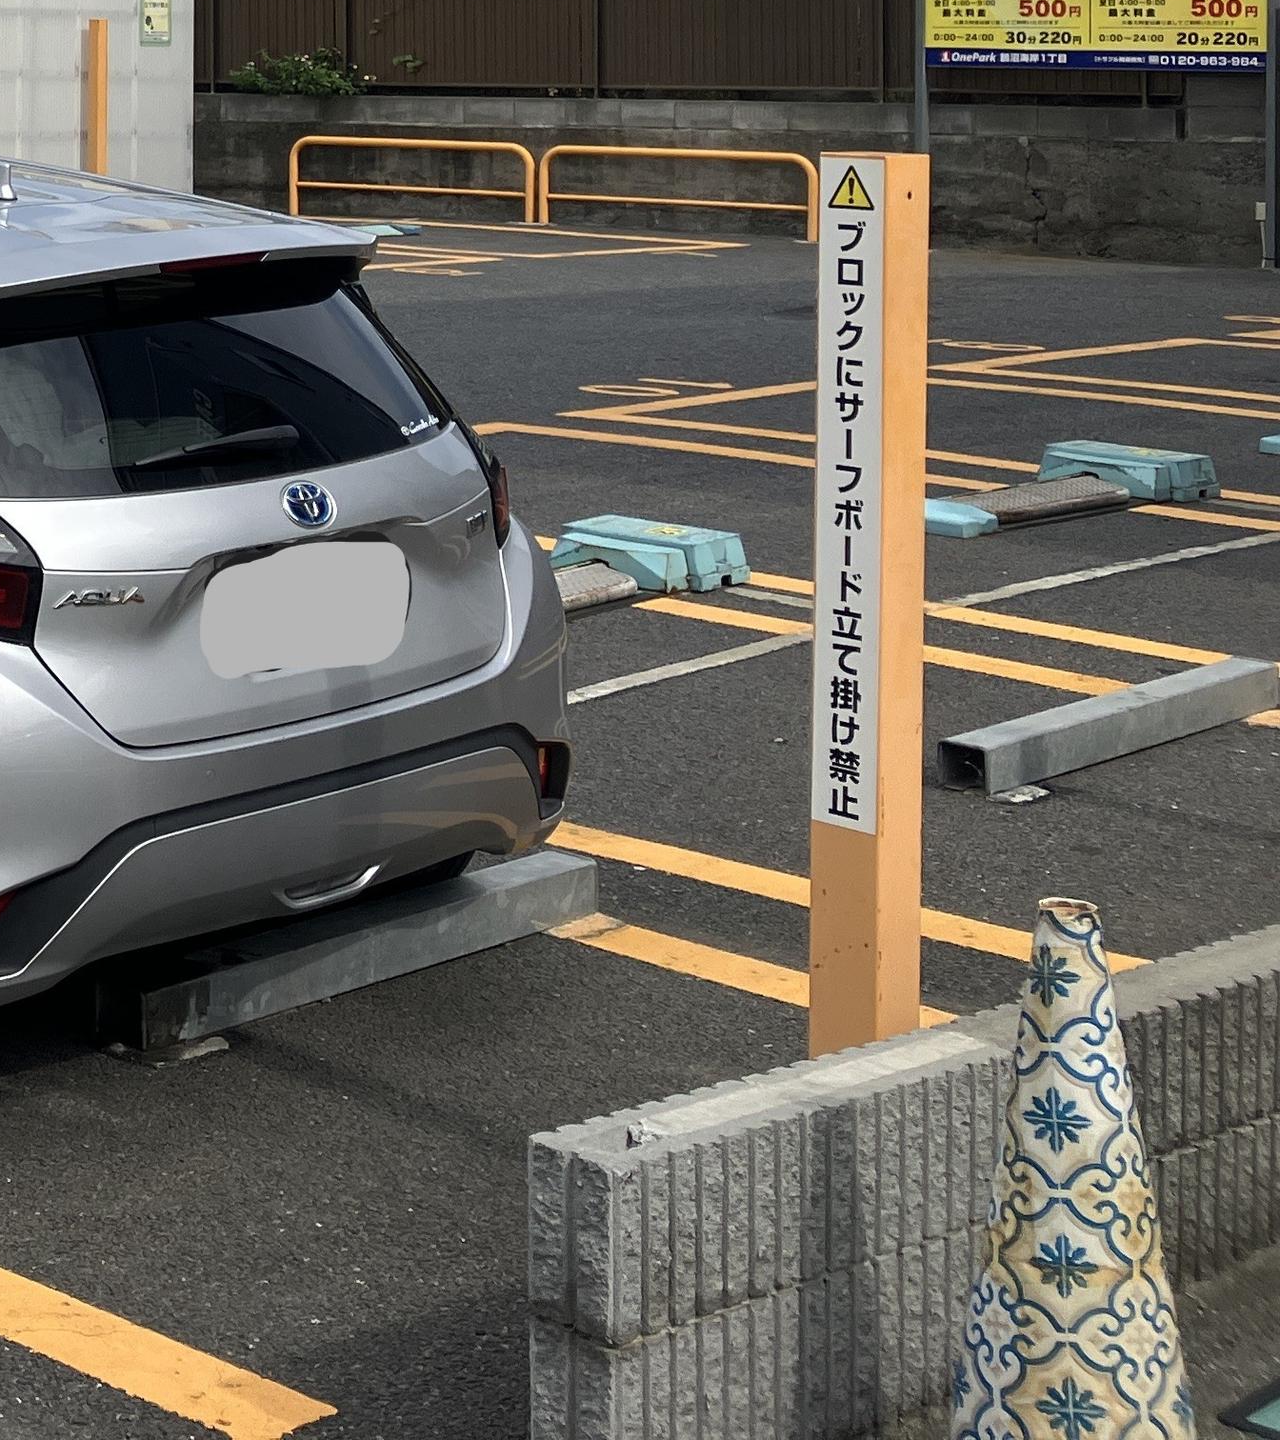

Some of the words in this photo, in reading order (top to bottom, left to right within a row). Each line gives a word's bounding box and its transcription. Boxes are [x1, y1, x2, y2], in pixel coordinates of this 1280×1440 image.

[1018, 0, 1081, 18] 500円
[951, 51, 997, 63] OnePark
[828, 220, 867, 821] ブロックにサーフボード立て掛け禁止
